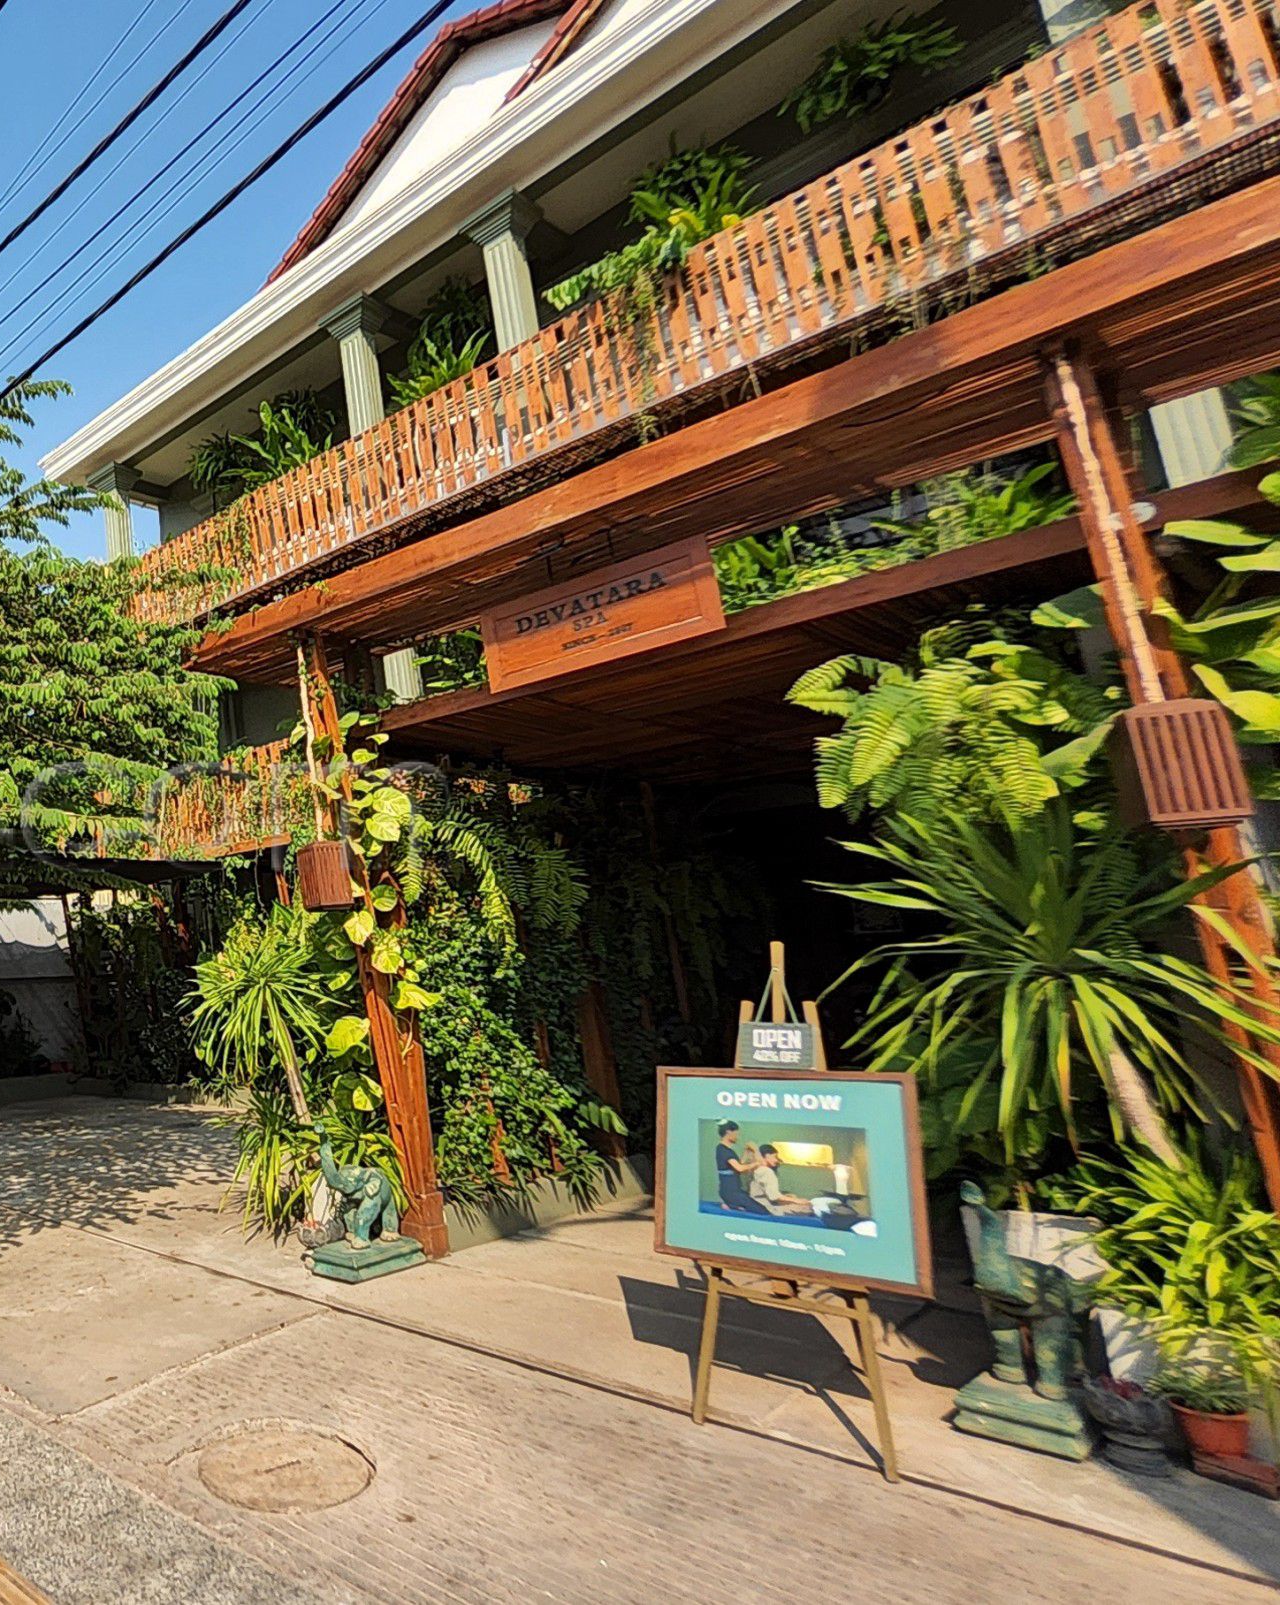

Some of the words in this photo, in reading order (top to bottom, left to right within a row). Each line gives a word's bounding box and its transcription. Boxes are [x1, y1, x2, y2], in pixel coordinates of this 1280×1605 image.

[515, 572, 667, 634] DEVATARA
[572, 611, 607, 632] SPA
[752, 1029, 802, 1050] OPEN
[716, 1091, 777, 1109] OPEN
[783, 1093, 842, 1111] NOW
